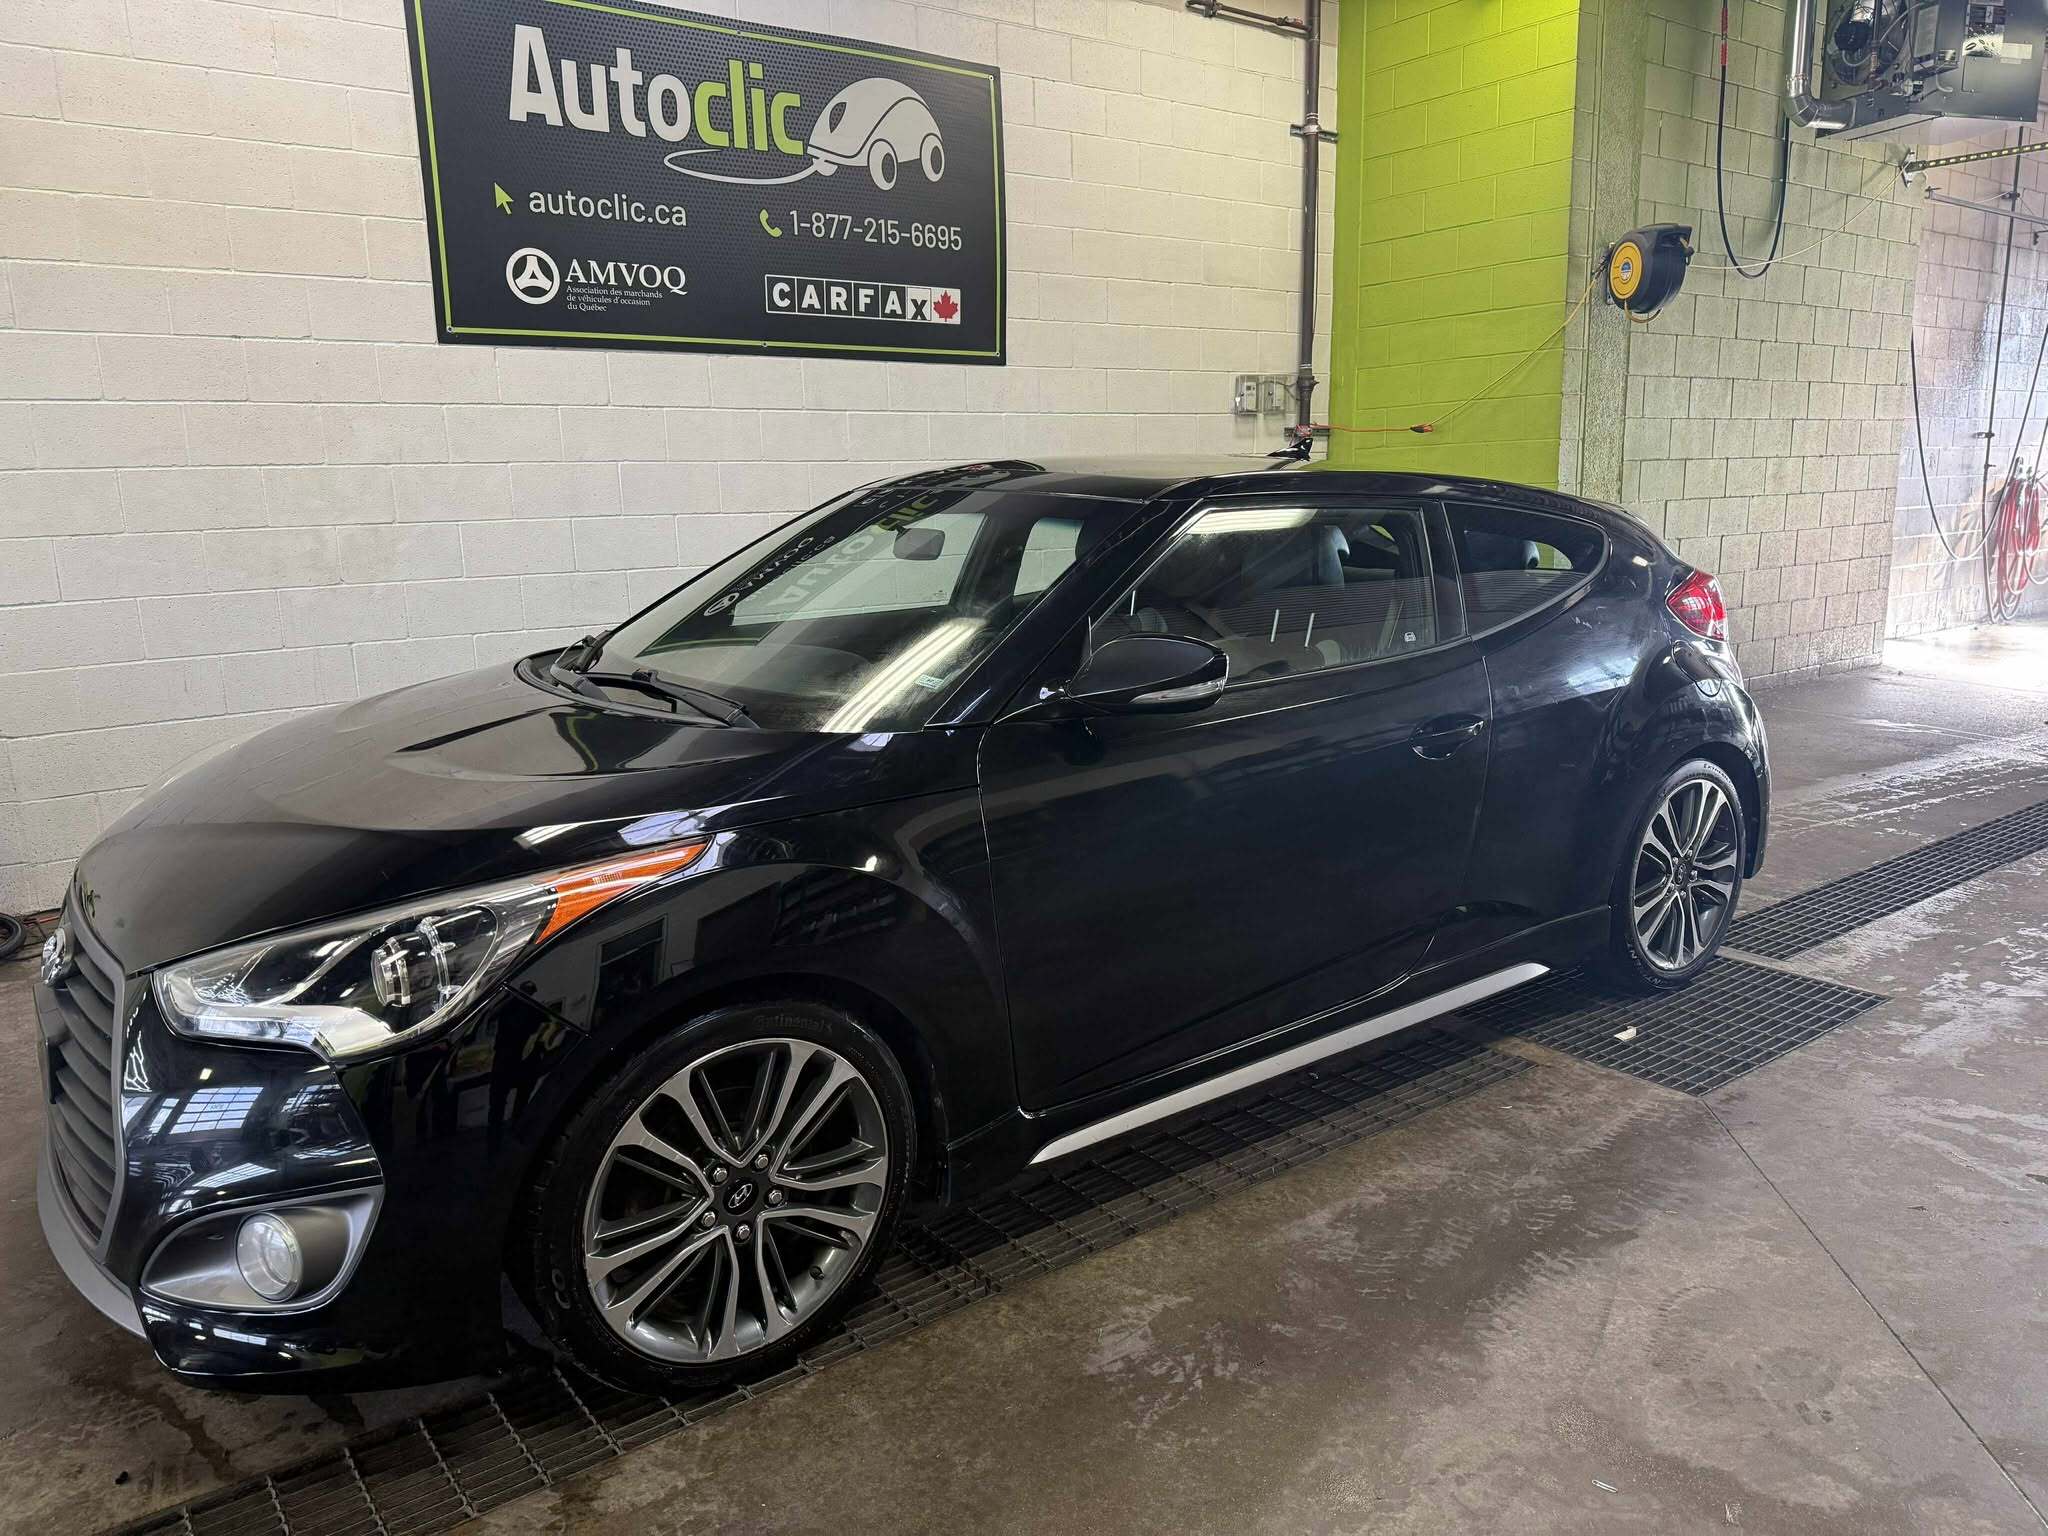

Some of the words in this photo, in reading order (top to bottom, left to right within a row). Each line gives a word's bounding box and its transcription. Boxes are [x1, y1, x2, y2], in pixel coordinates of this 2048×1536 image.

[509, 24, 804, 156] Autoclic
[529, 191, 687, 226] autoclic.ca
[789, 210, 963, 251] 1-877-215-6695
[565, 258, 688, 296] AMVOQ
[566, 285, 608, 295] Association
[610, 288, 622, 296] des
[624, 290, 663, 299] marchands
[578, 295, 612, 304] véhicules
[579, 303, 607, 312] Québec
[772, 281, 928, 321] CARFAX
